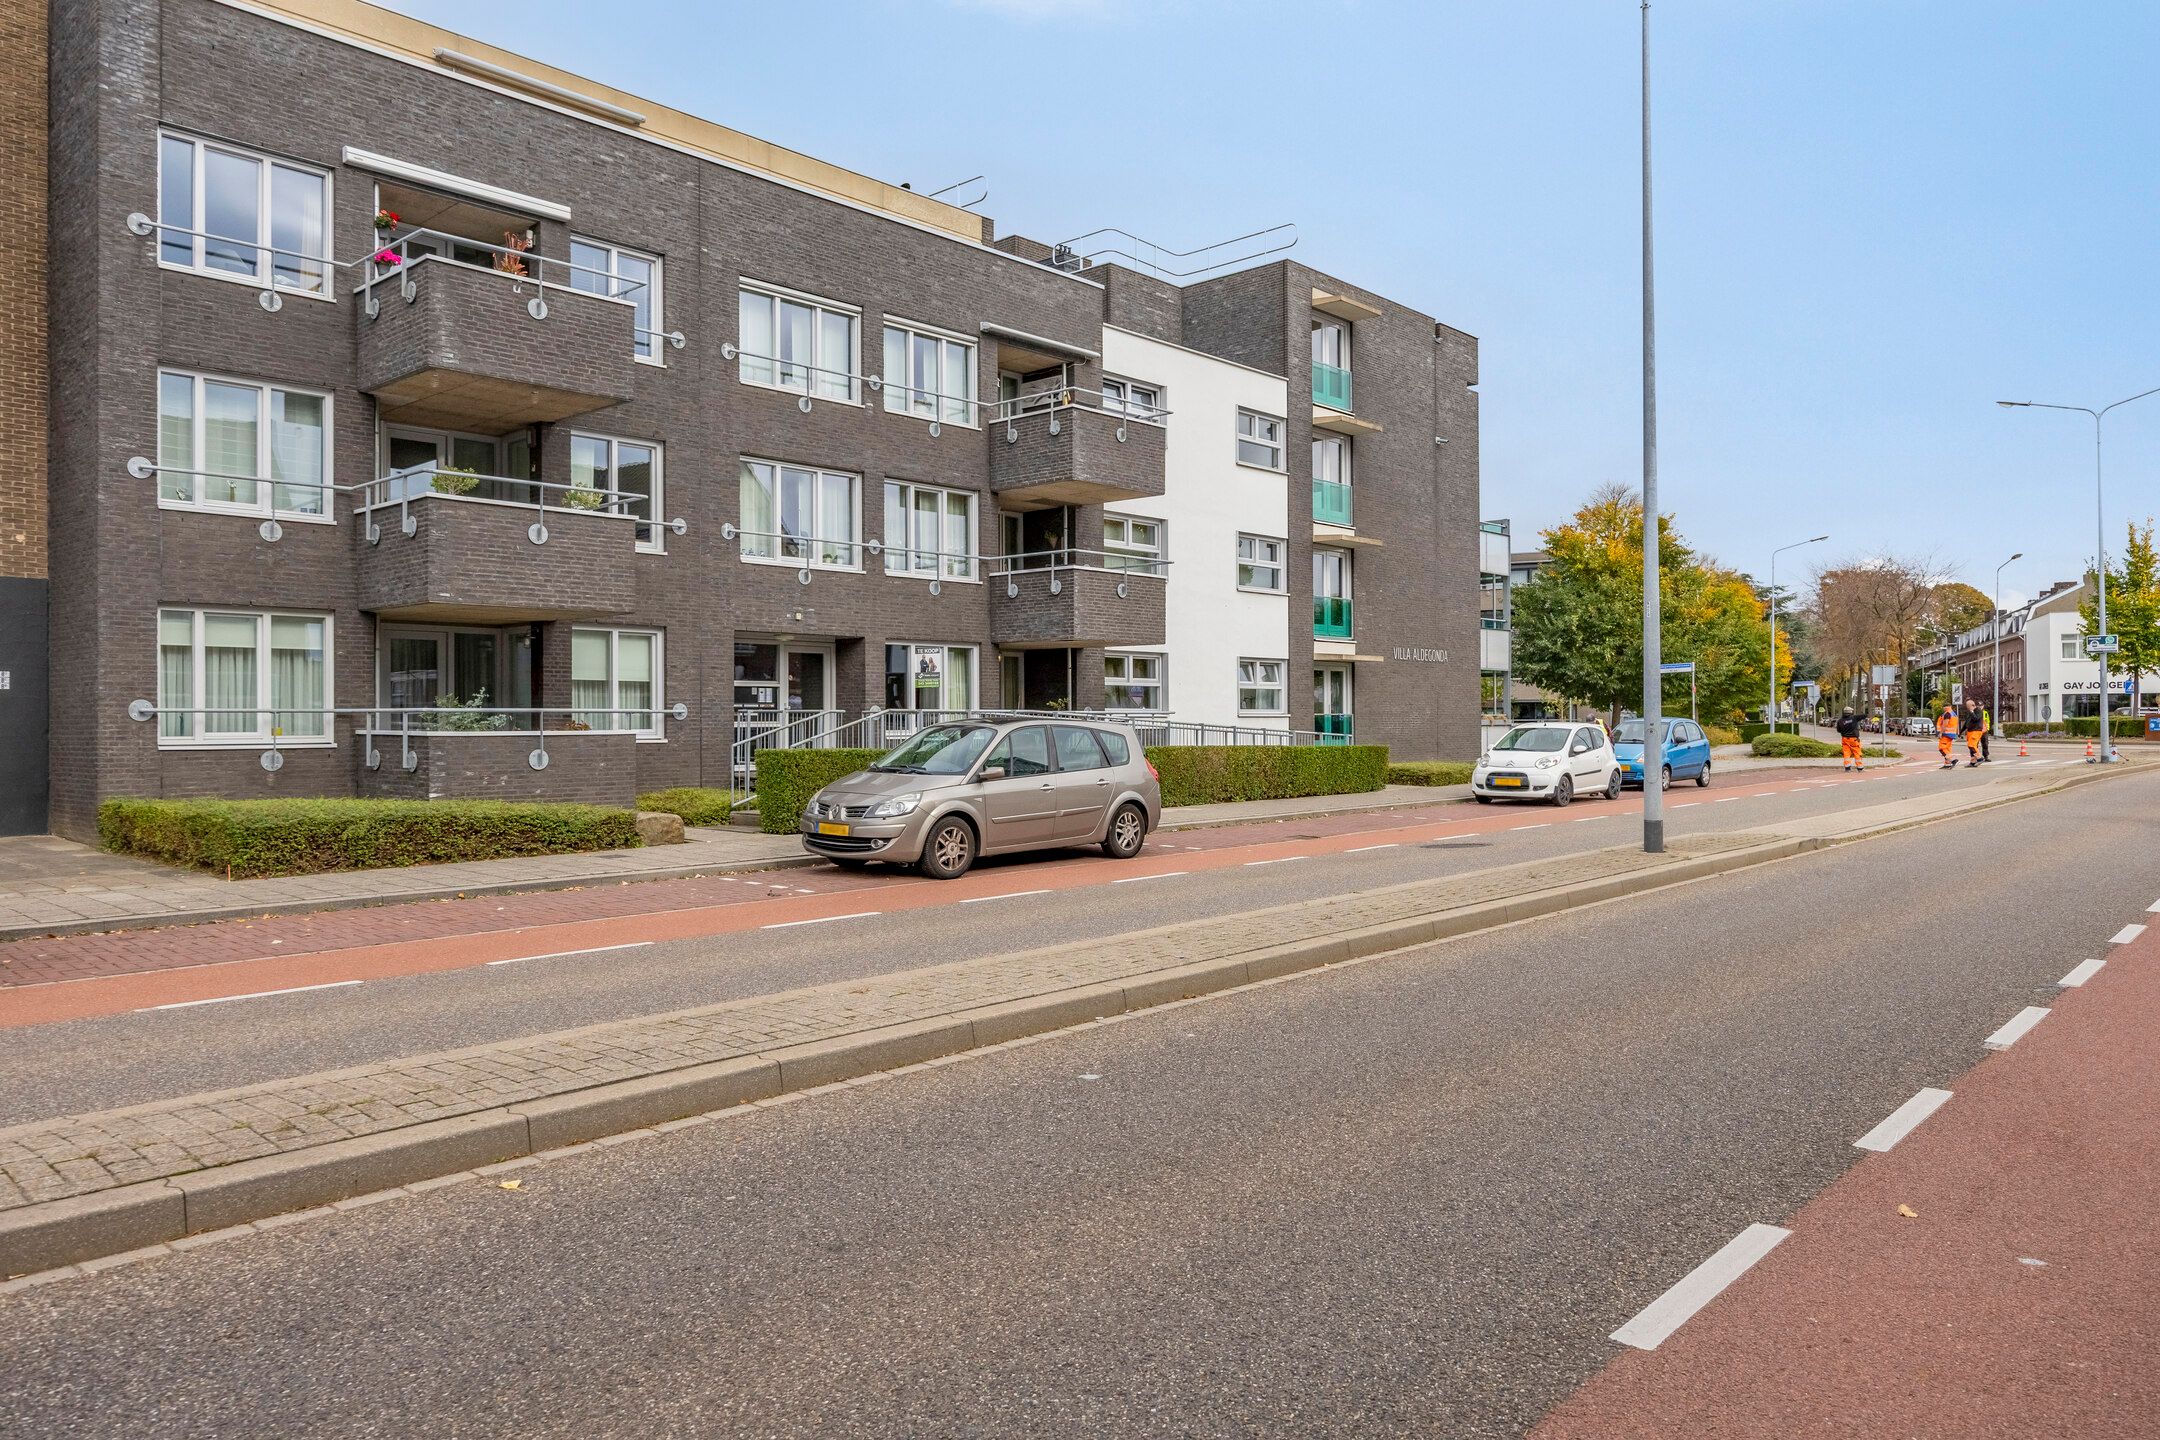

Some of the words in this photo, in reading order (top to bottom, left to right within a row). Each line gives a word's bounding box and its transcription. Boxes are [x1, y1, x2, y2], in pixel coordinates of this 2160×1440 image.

[1393, 647, 1411, 660] VILLA
[1412, 648, 1449, 662] ALDEGONDA
[2063, 682, 2084, 690] GAY
[2086, 681, 2126, 690] JOGE
